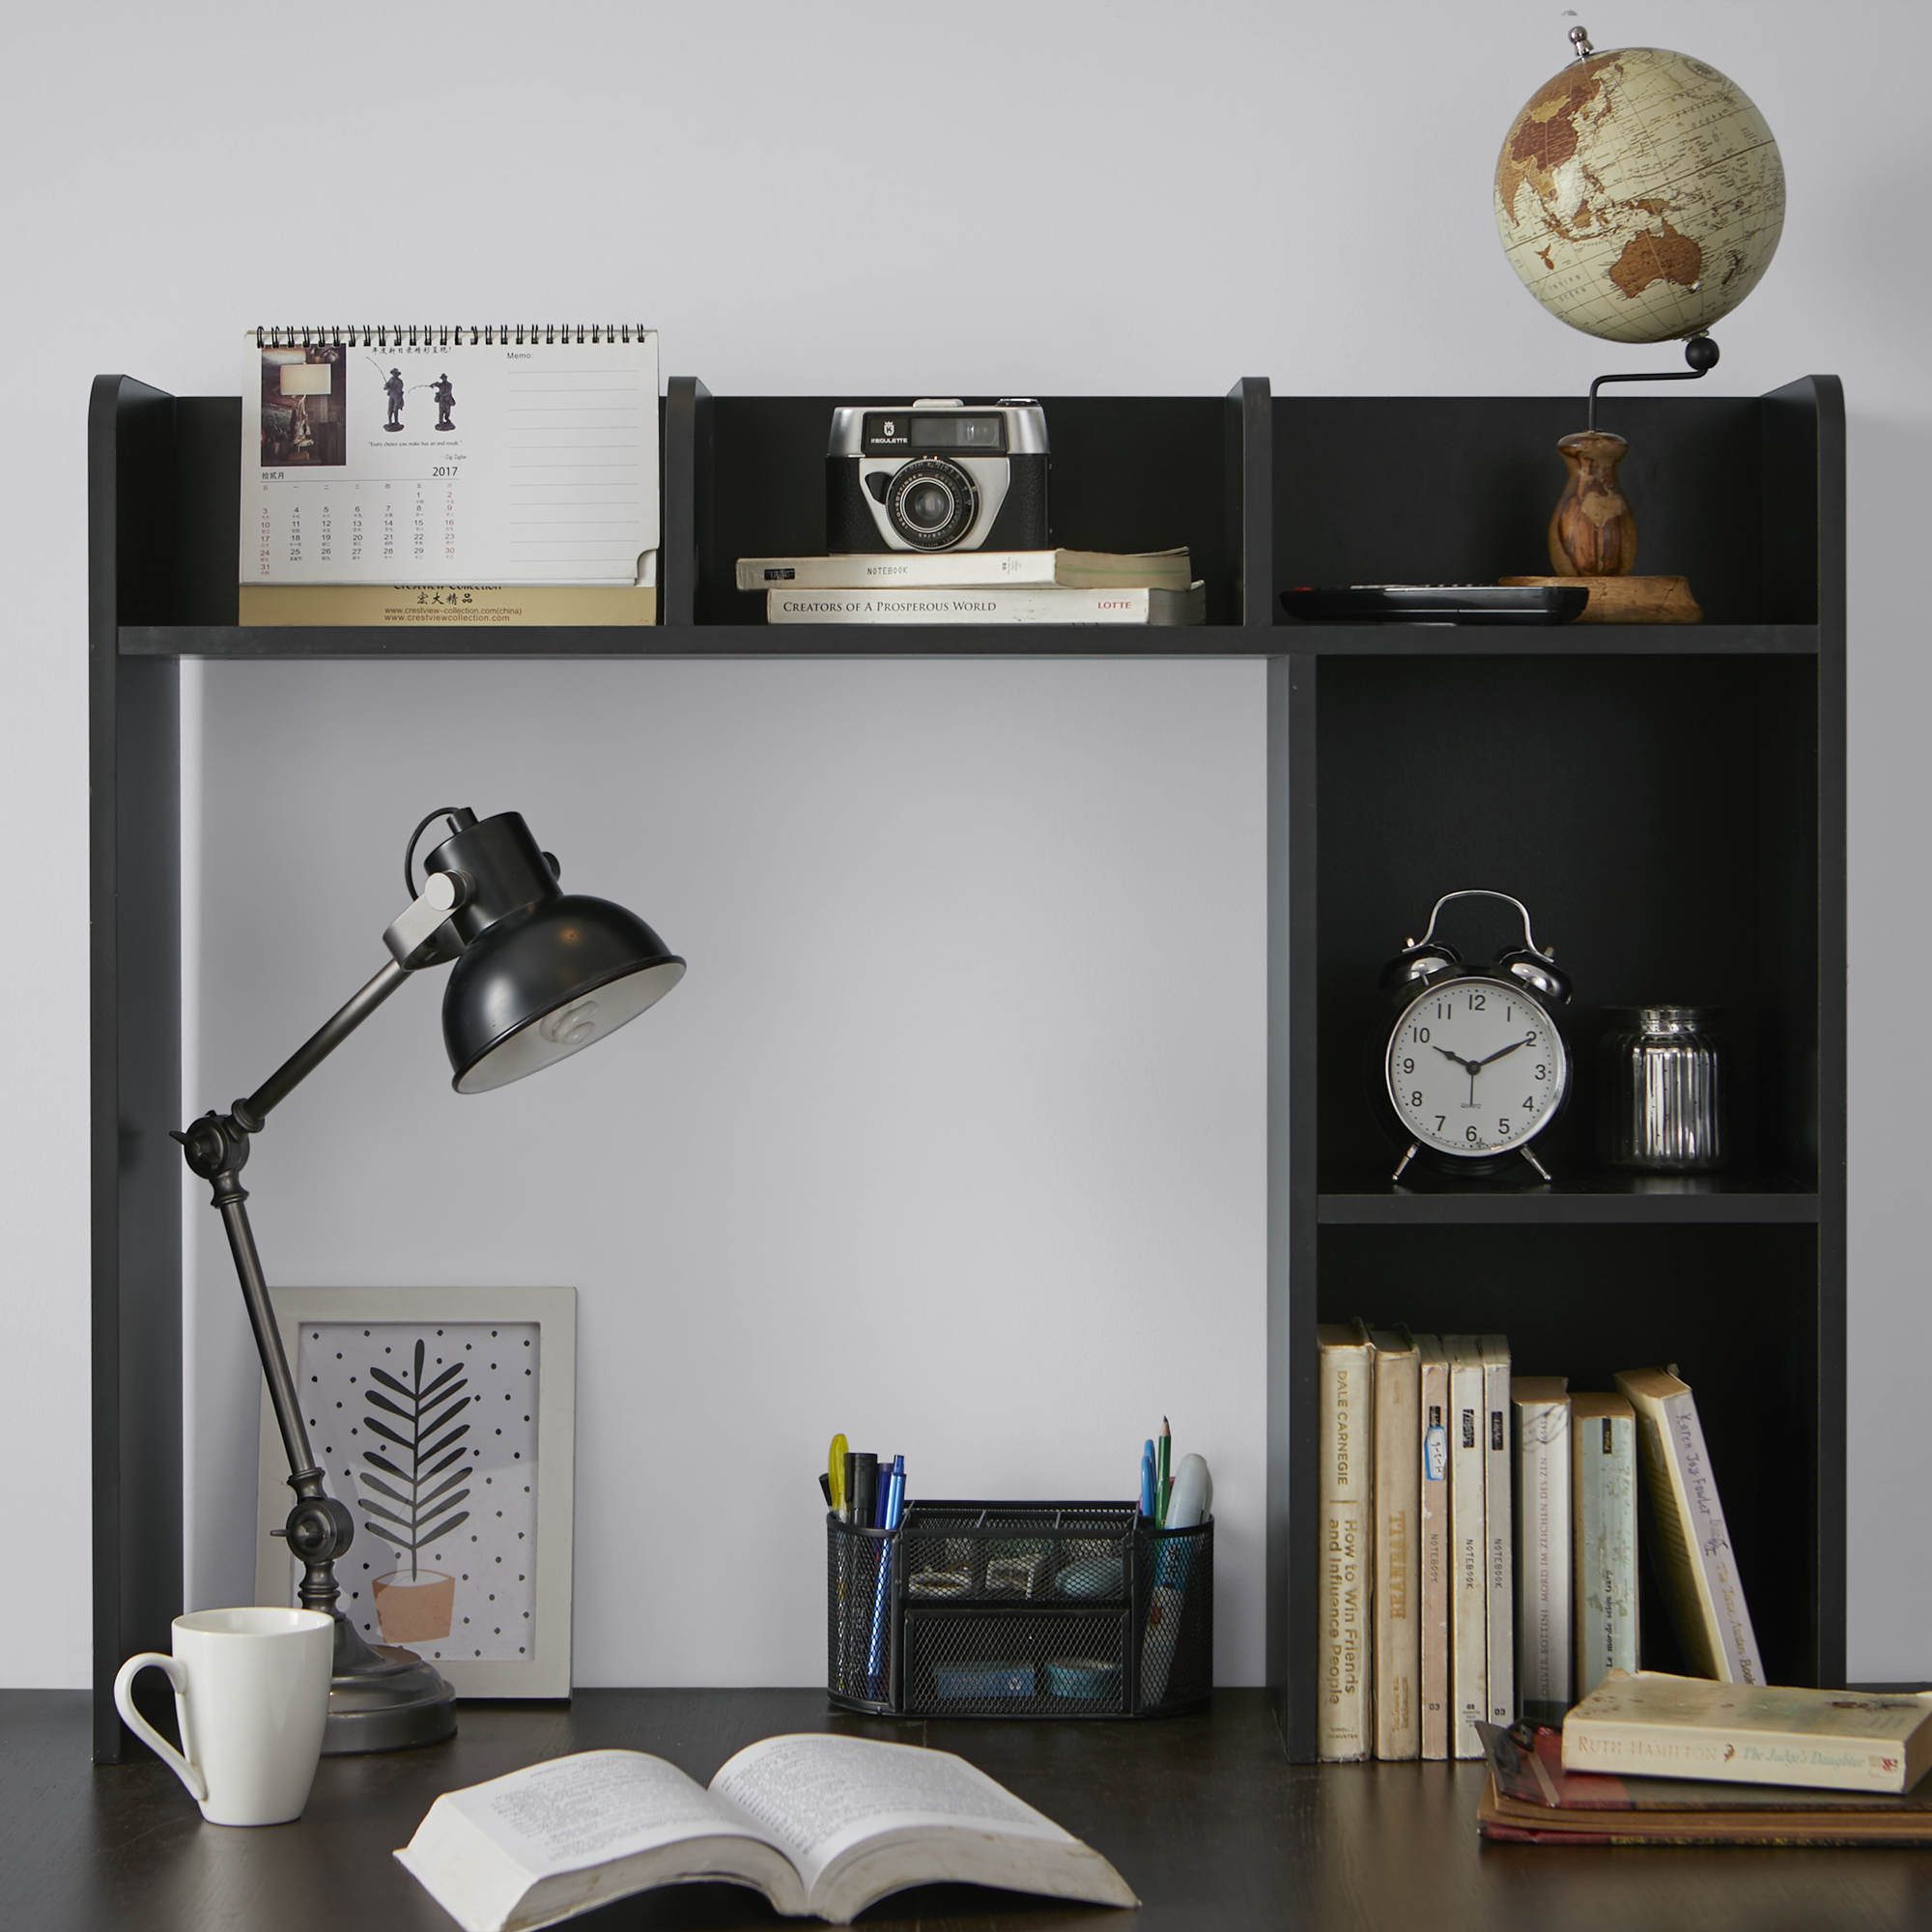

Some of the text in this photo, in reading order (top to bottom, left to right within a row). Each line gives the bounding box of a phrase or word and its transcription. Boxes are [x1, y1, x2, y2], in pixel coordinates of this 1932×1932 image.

[506, 352, 534, 360] Memo:
[432, 466, 458, 477] 2017
[323, 505, 329, 514] 5
[260, 521, 270, 529] 10
[321, 533, 331, 542] 19
[352, 533, 363, 542] 20
[413, 532, 425, 541] 22
[259, 549, 270, 557] 24
[383, 547, 394, 555] 28
[867, 566, 908, 576] NOTEBOOK
[416, 591, 473, 606] 宏大精品
[782, 601, 997, 612] CREATORS OF A PROSPEROUS WORLD
[1097, 601, 1132, 610] LOTTE
[384, 607, 523, 616] www.crestview-collection.com(china)
[1468, 994, 1486, 1011] 12
[1437, 1003, 1452, 1020] 11
[1506, 1006, 1512, 1022] 1
[1413, 1027, 1431, 1043] 10
[1525, 1031, 1537, 1047] 2
[1403, 1058, 1415, 1074] 9
[1534, 1064, 1546, 1081] 3
[1411, 1091, 1423, 1107] 8
[1521, 1095, 1534, 1112] 4
[1435, 1115, 1446, 1132] 7
[1498, 1118, 1510, 1135] 5
[1465, 1125, 1477, 1142] 6
[1337, 1370, 1349, 1486] DALE CARNEGIE
[1676, 1414, 1711, 1516] Karen Joy Fowler
[1539, 1457, 1549, 1604] MORD IM ZEICHEN DES ZEN
[1431, 1534, 1439, 1584] NOTEBOOK
[1465, 1539, 1475, 1590] NOTEBOOK
[1493, 1538, 1503, 1589] NOTEBOOK
[1715, 1562, 1729, 1585] The
[1722, 1586, 1735, 1618] Jane
[1329, 1520, 1343, 1705] and Influence People
[1345, 1520, 1358, 1693] How to Win Friends
[1604, 1596, 1613, 1619] selon
[1605, 1623, 1613, 1653] monde
[1540, 1609, 1549, 1697] OLIVER BOTTINI
[1605, 1656, 1614, 1668] Le
[1577, 1735, 1718, 1762] RUTH HAMILTON
[1742, 1746, 1865, 1770] The Judge's Daughter
